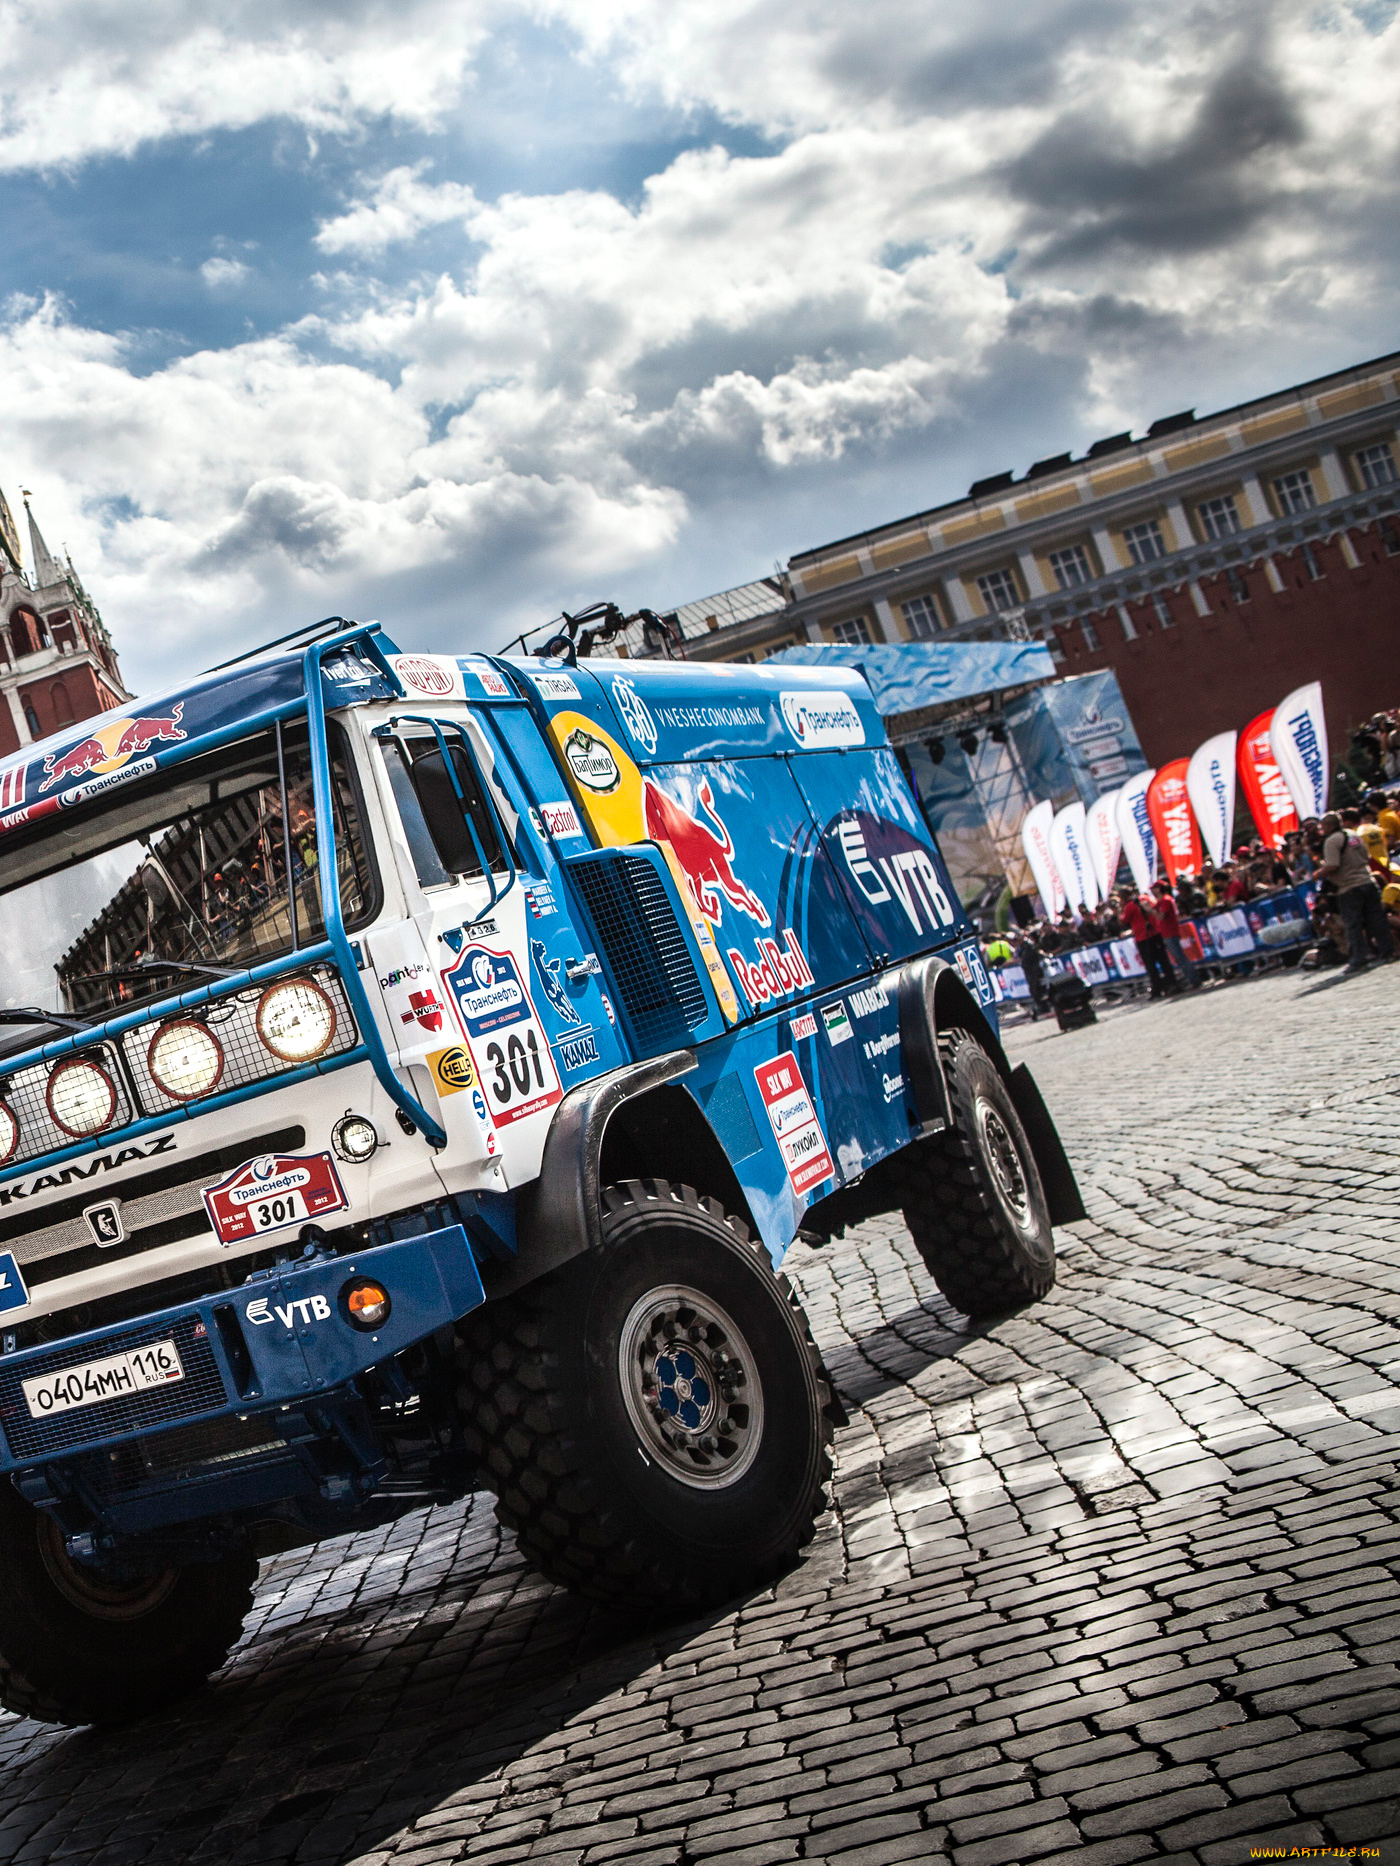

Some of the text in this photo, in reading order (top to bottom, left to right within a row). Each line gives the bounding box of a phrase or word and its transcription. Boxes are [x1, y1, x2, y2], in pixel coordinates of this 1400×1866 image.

[654, 707, 766, 728] VNESHECONOMBANK
[800, 707, 860, 735] Транснефть
[82, 760, 154, 796] Транснефть
[2, 808, 31, 828] WAY
[542, 806, 579, 834] Castrol
[880, 850, 954, 936] VTB
[728, 930, 815, 1003] Red Bull
[464, 987, 518, 1012] Транснефть
[848, 983, 890, 1019] WABCO
[791, 1016, 816, 1039] LOCTITE
[487, 1029, 545, 1104] 301
[560, 1035, 600, 1071] KAMAZ
[443, 1058, 473, 1077] HELLA
[792, 1131, 820, 1158] ЛУКОЙЛ
[233, 1173, 305, 1201] Транснефть
[221, 1211, 248, 1226] SILK WAY
[257, 1196, 296, 1227] 301
[274, 1294, 332, 1329] VTB
[132, 1347, 172, 1376] 116
[145, 1370, 165, 1384] RUS
